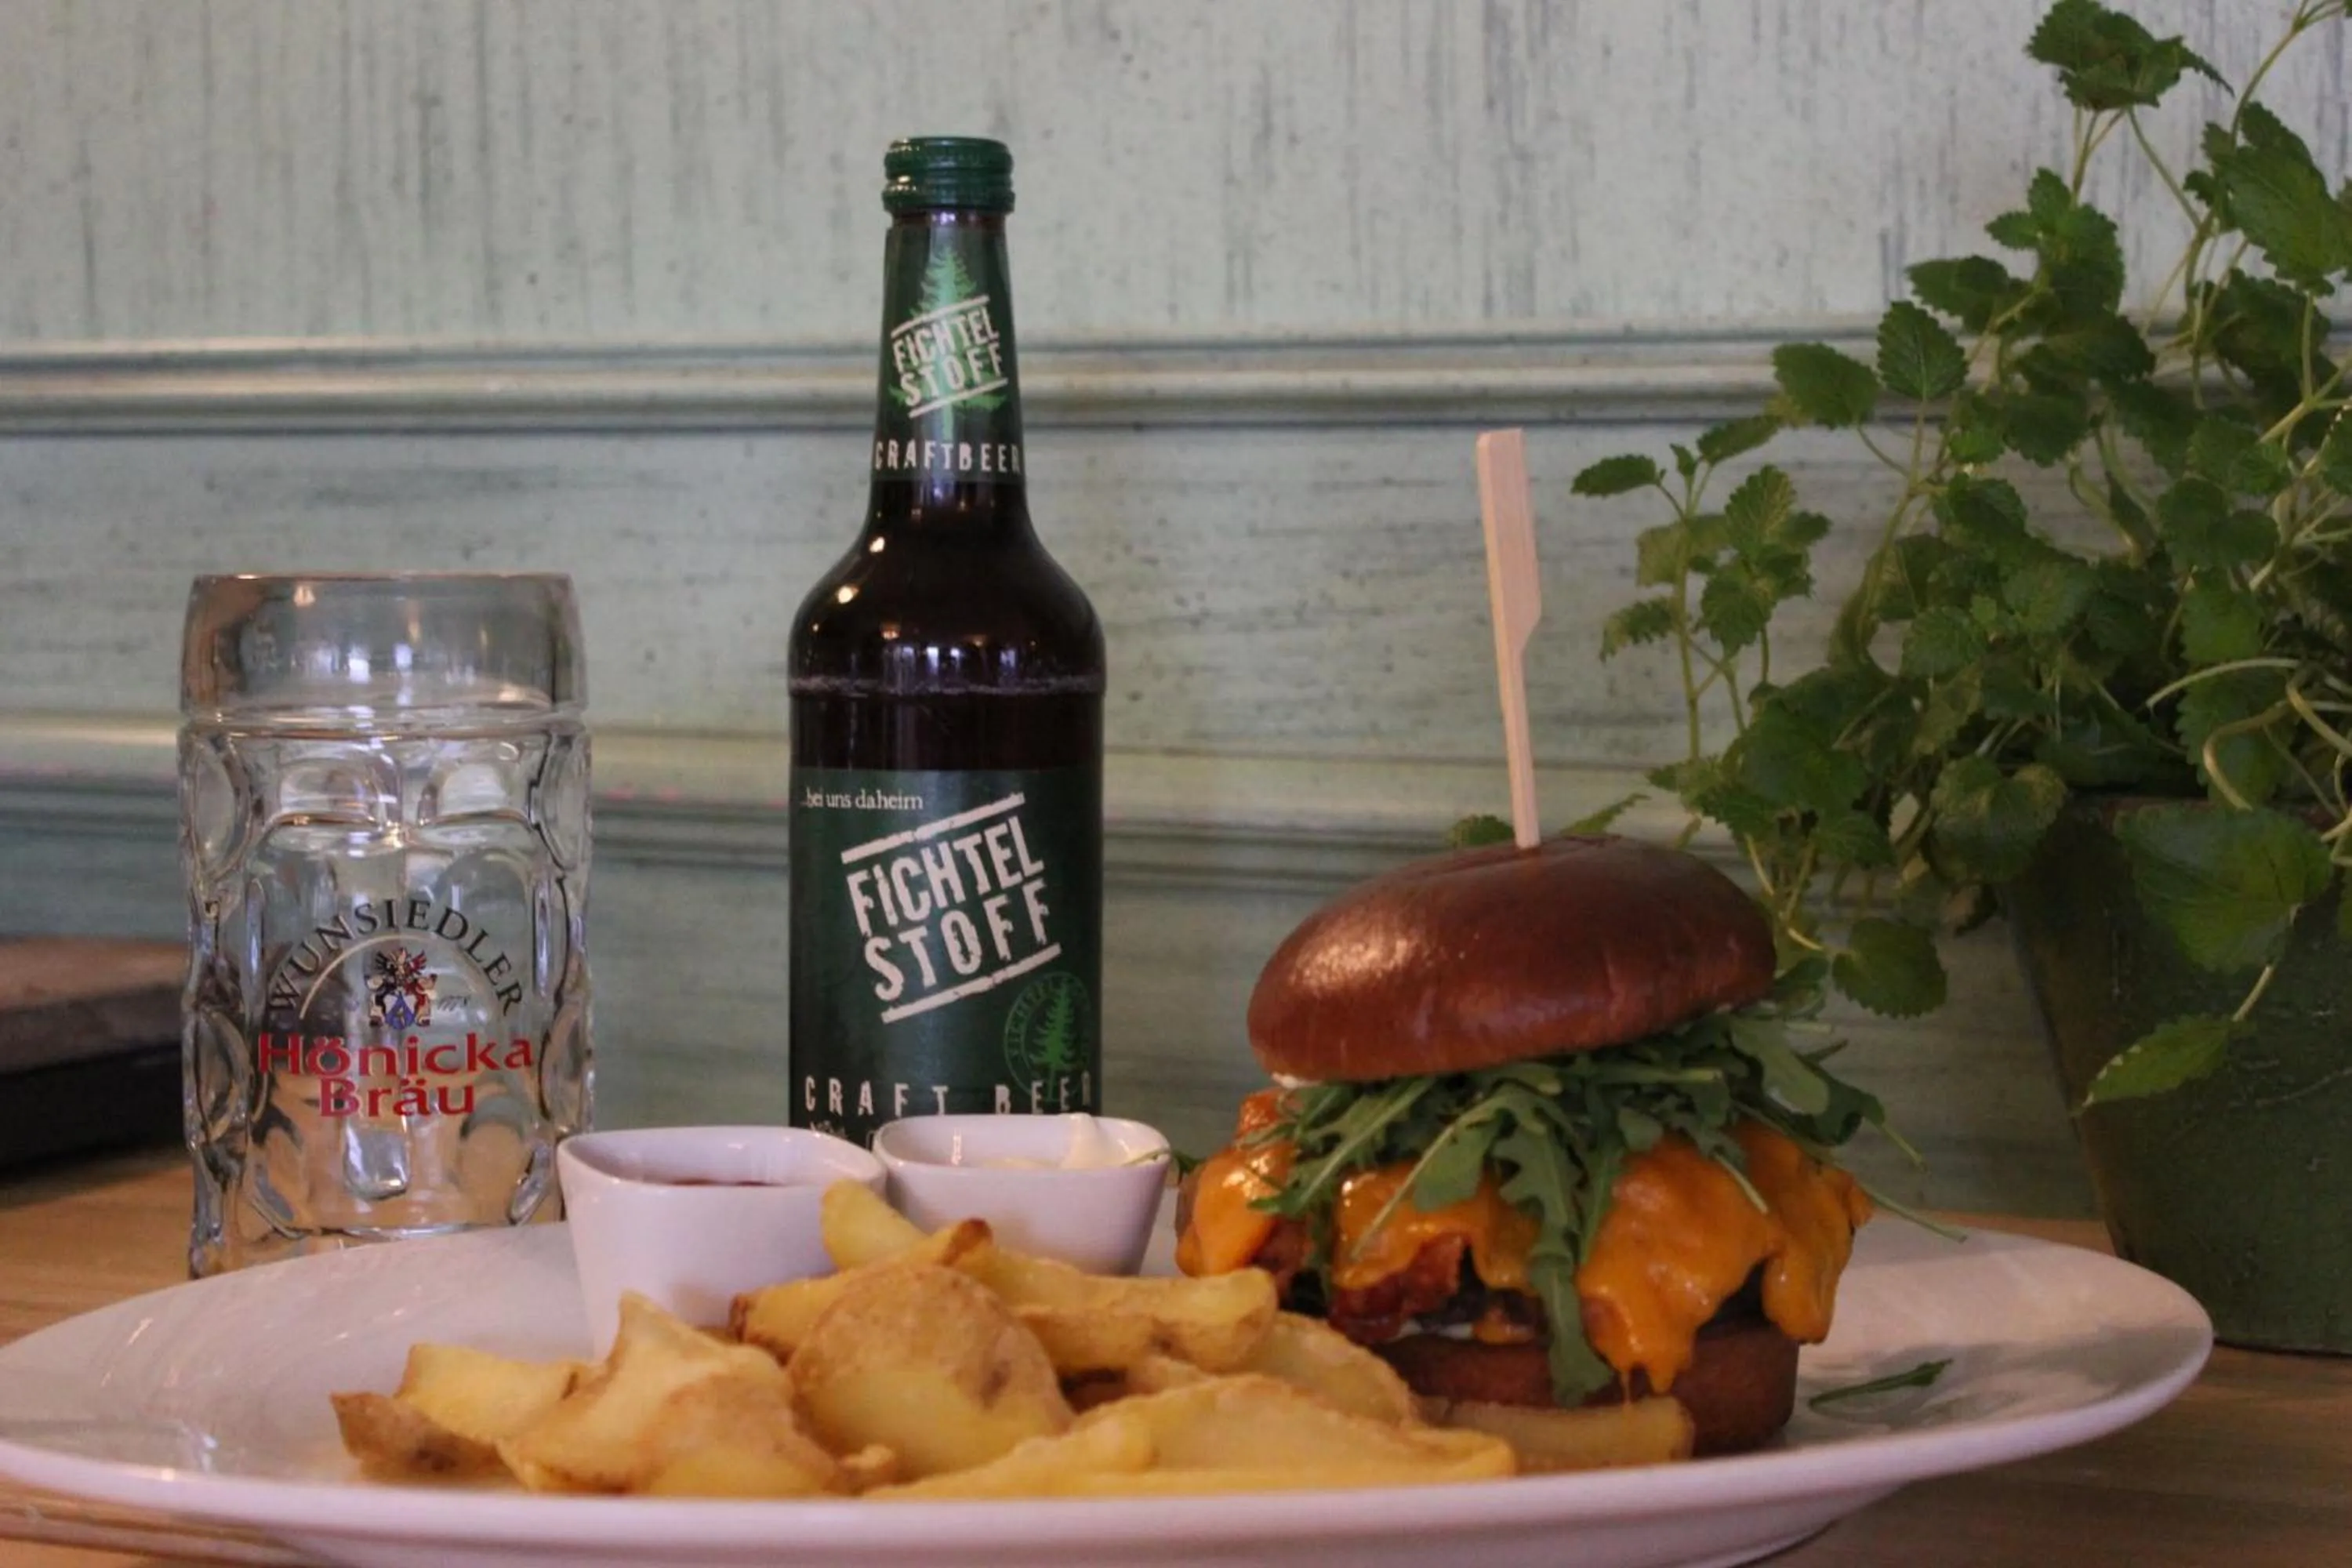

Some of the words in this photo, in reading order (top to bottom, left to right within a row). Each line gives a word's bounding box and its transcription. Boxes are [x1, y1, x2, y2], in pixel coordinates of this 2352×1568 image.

[893, 306, 1000, 373] FICHTEL
[900, 343, 1004, 408] STOFF
[826, 793, 852, 809] uns
[855, 788, 924, 810] daheim
[846, 816, 1044, 938] FICHTEL
[268, 898, 523, 1016] WUNSIEDLER
[864, 879, 1050, 1001] STOFF
[257, 1033, 535, 1077] Hönicka
[318, 1077, 476, 1118] Bräu
[804, 1075, 949, 1117] CRAFT
